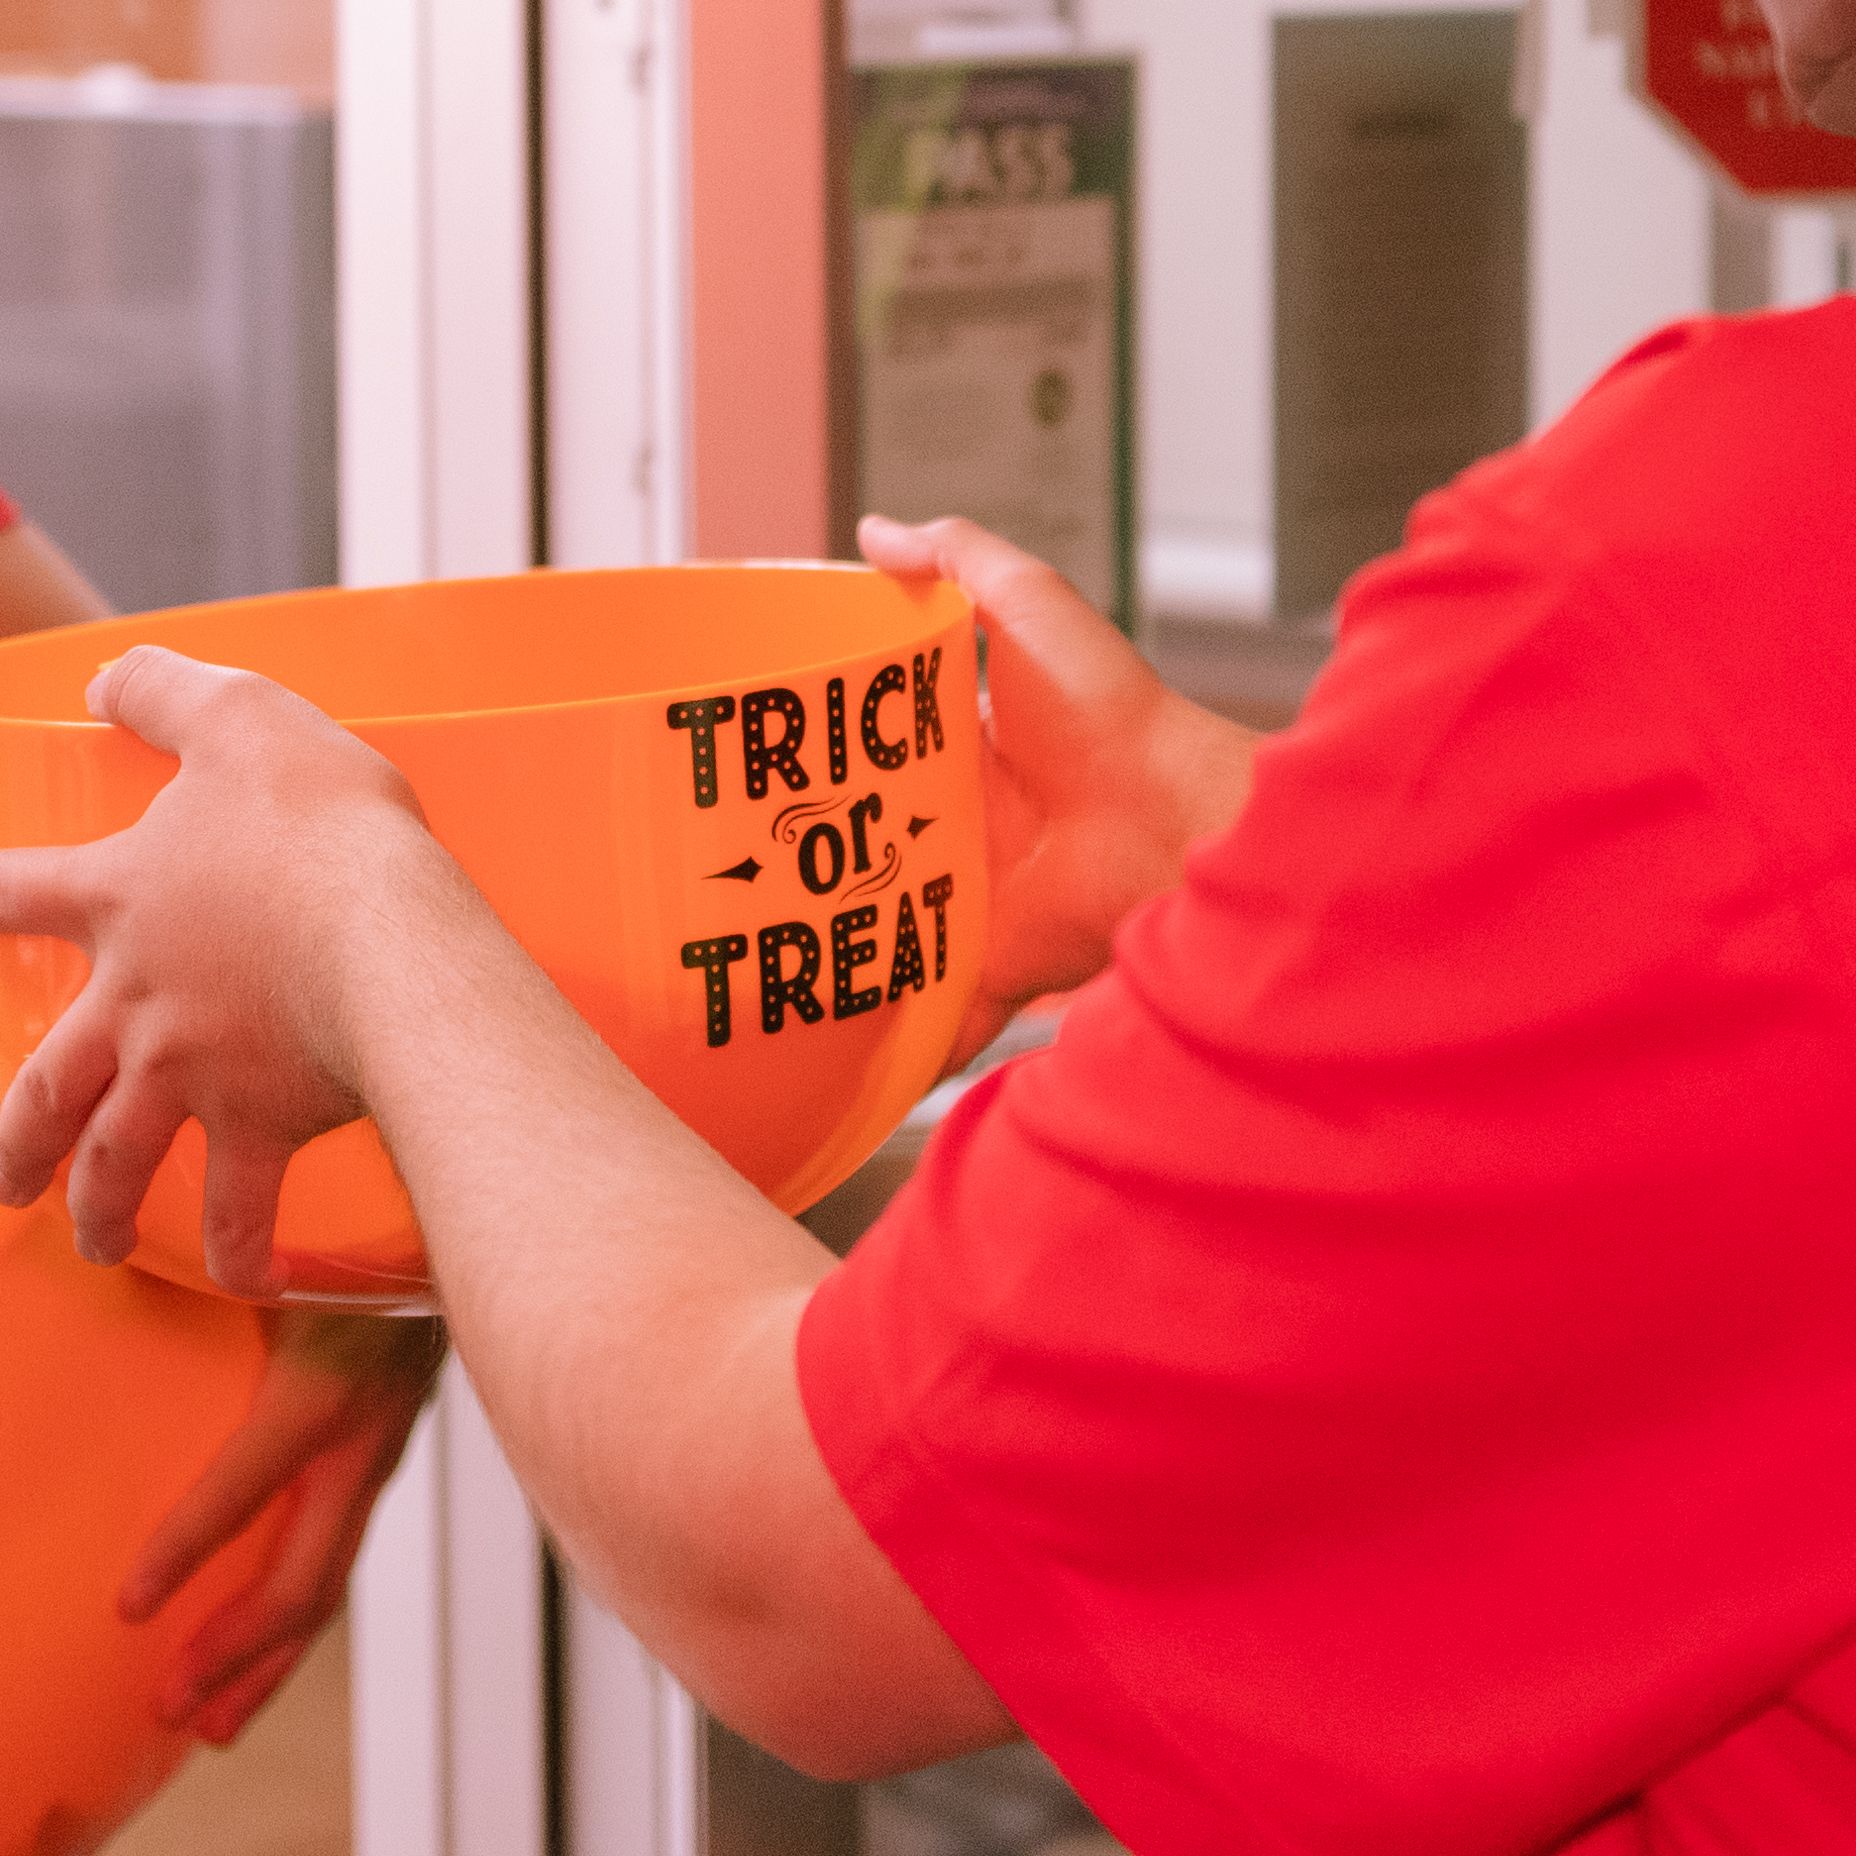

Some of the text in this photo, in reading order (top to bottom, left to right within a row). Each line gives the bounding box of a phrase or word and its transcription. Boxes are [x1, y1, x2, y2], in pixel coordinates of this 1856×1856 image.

[902, 124, 1077, 206] PASS
[667, 647, 945, 809] TRICK
[797, 792, 883, 896] or
[681, 873, 953, 1048] TREAT
